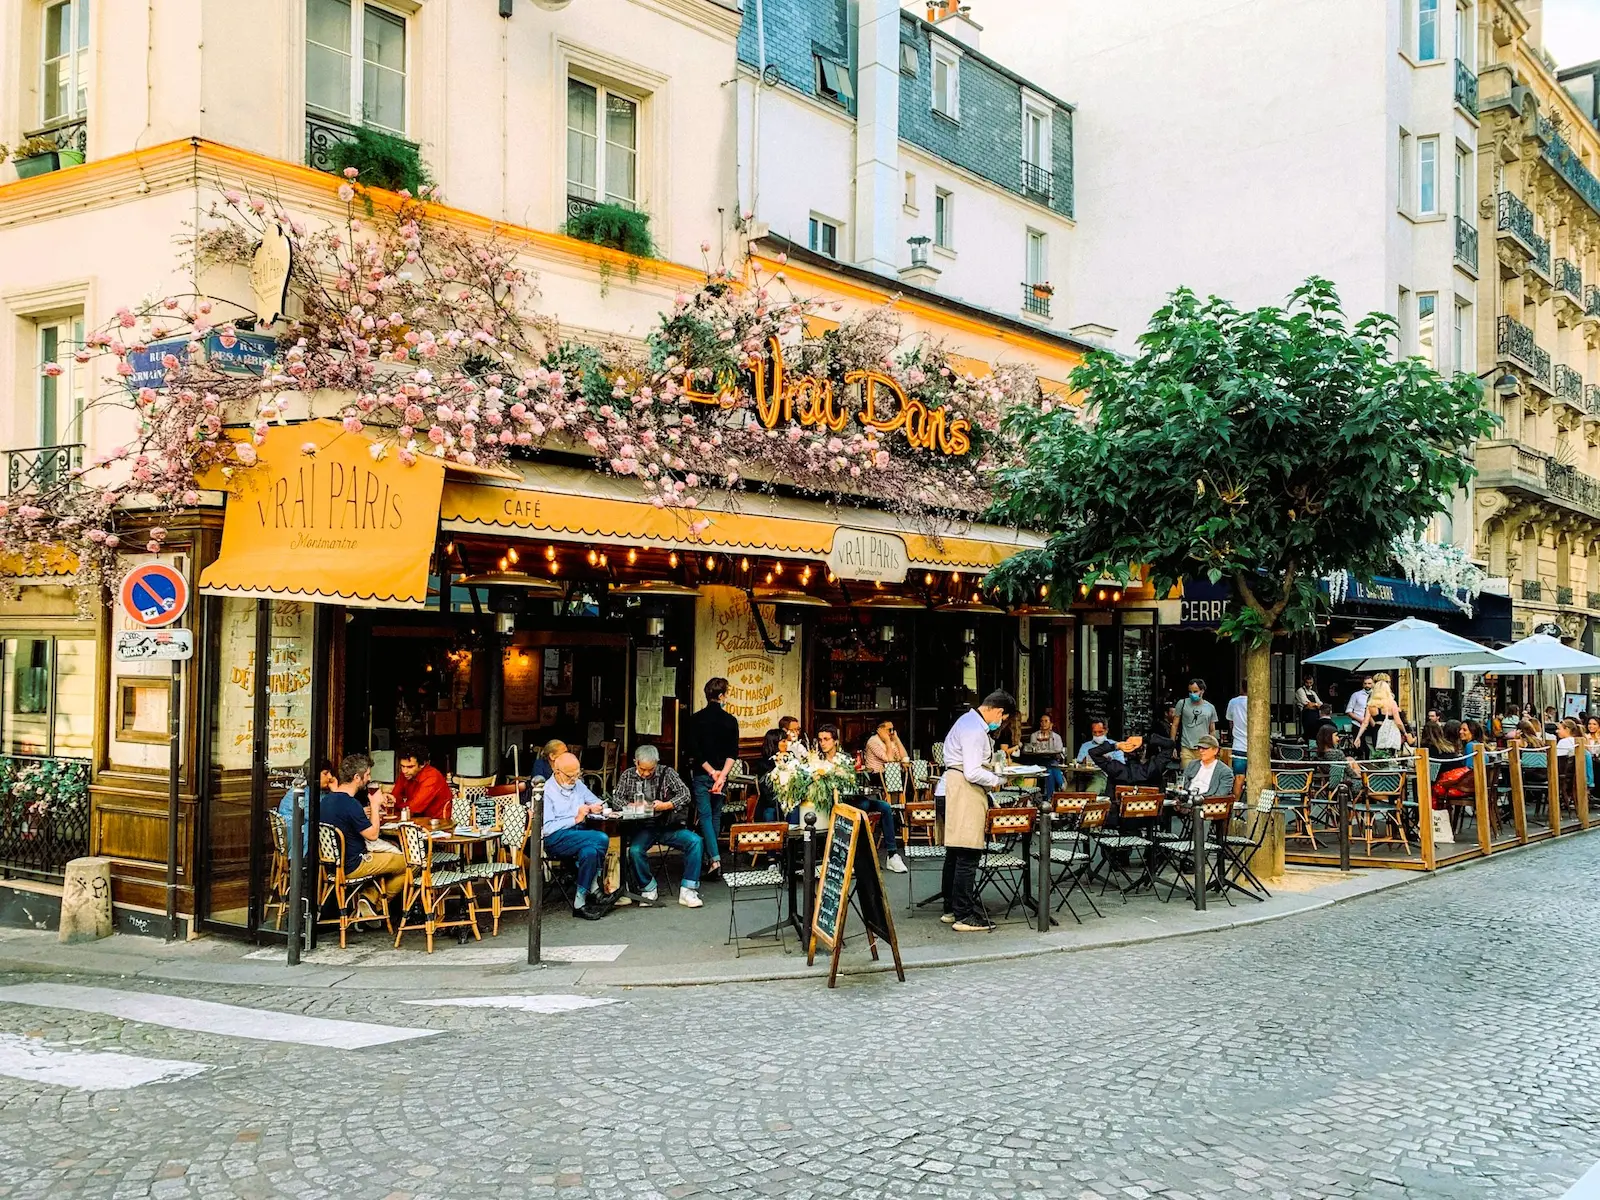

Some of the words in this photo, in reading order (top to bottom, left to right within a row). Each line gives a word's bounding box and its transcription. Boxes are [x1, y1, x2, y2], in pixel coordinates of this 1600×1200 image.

[131, 369, 163, 382] ERMAIN
[749, 335, 848, 431] Vrai
[257, 462, 316, 529] VRAI
[328, 461, 403, 530] PARIS
[504, 499, 541, 518] CAFÉ
[290, 531, 358, 550] Montmartre
[838, 535, 865, 565] VRAI
[870, 536, 900, 570] PARIS
[716, 629, 779, 653] Restaura
[727, 661, 757, 677] PRODUITS
[758, 661, 775, 676] FRAIS
[748, 673, 754, 685] &
[726, 684, 744, 700] FAIT
[745, 683, 774, 700] MAISON
[725, 702, 754, 717] TOUTE
[755, 694, 784, 716] HEURE
